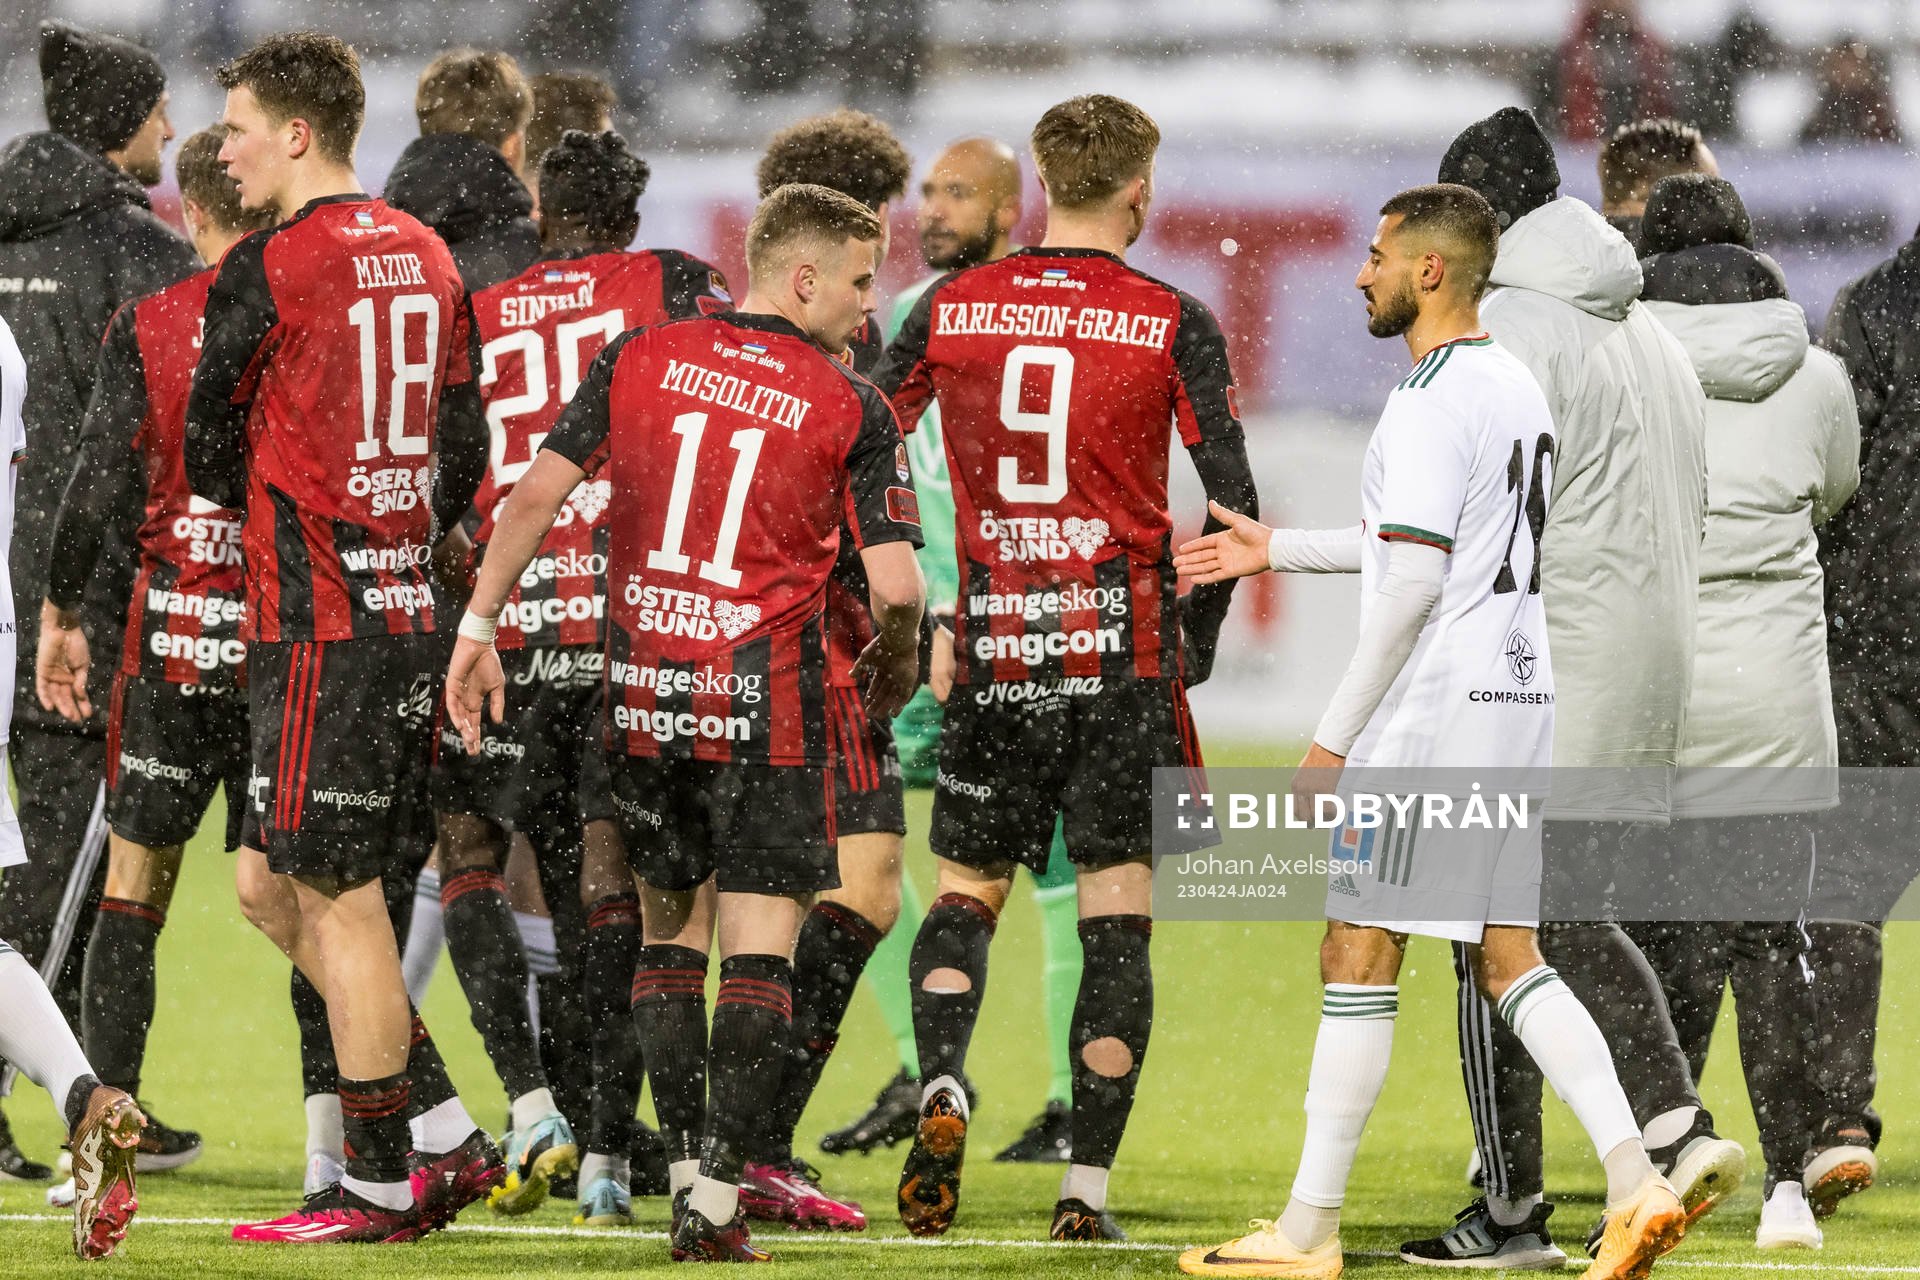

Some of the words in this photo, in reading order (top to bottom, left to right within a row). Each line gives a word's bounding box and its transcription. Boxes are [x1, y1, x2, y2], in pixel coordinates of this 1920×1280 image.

[352, 253, 427, 290] MAZUR
[935, 302, 1171, 350] KARLSSON-GRACH
[712, 340, 723, 353] Vi
[721, 347, 740, 359] ger
[347, 293, 440, 461] 18
[659, 359, 812, 431] MUSOLITIN
[997, 345, 1075, 504] 9
[646, 410, 766, 590] 11
[979, 509, 1060, 541] ÖSTER
[999, 538, 1070, 562] SUND
[624, 573, 712, 617] ÖSTER
[969, 582, 1128, 621] wangeskog
[636, 608, 719, 642] SUND
[610, 660, 762, 704] wangeskog
[1328, 883, 1362, 899] adidas
